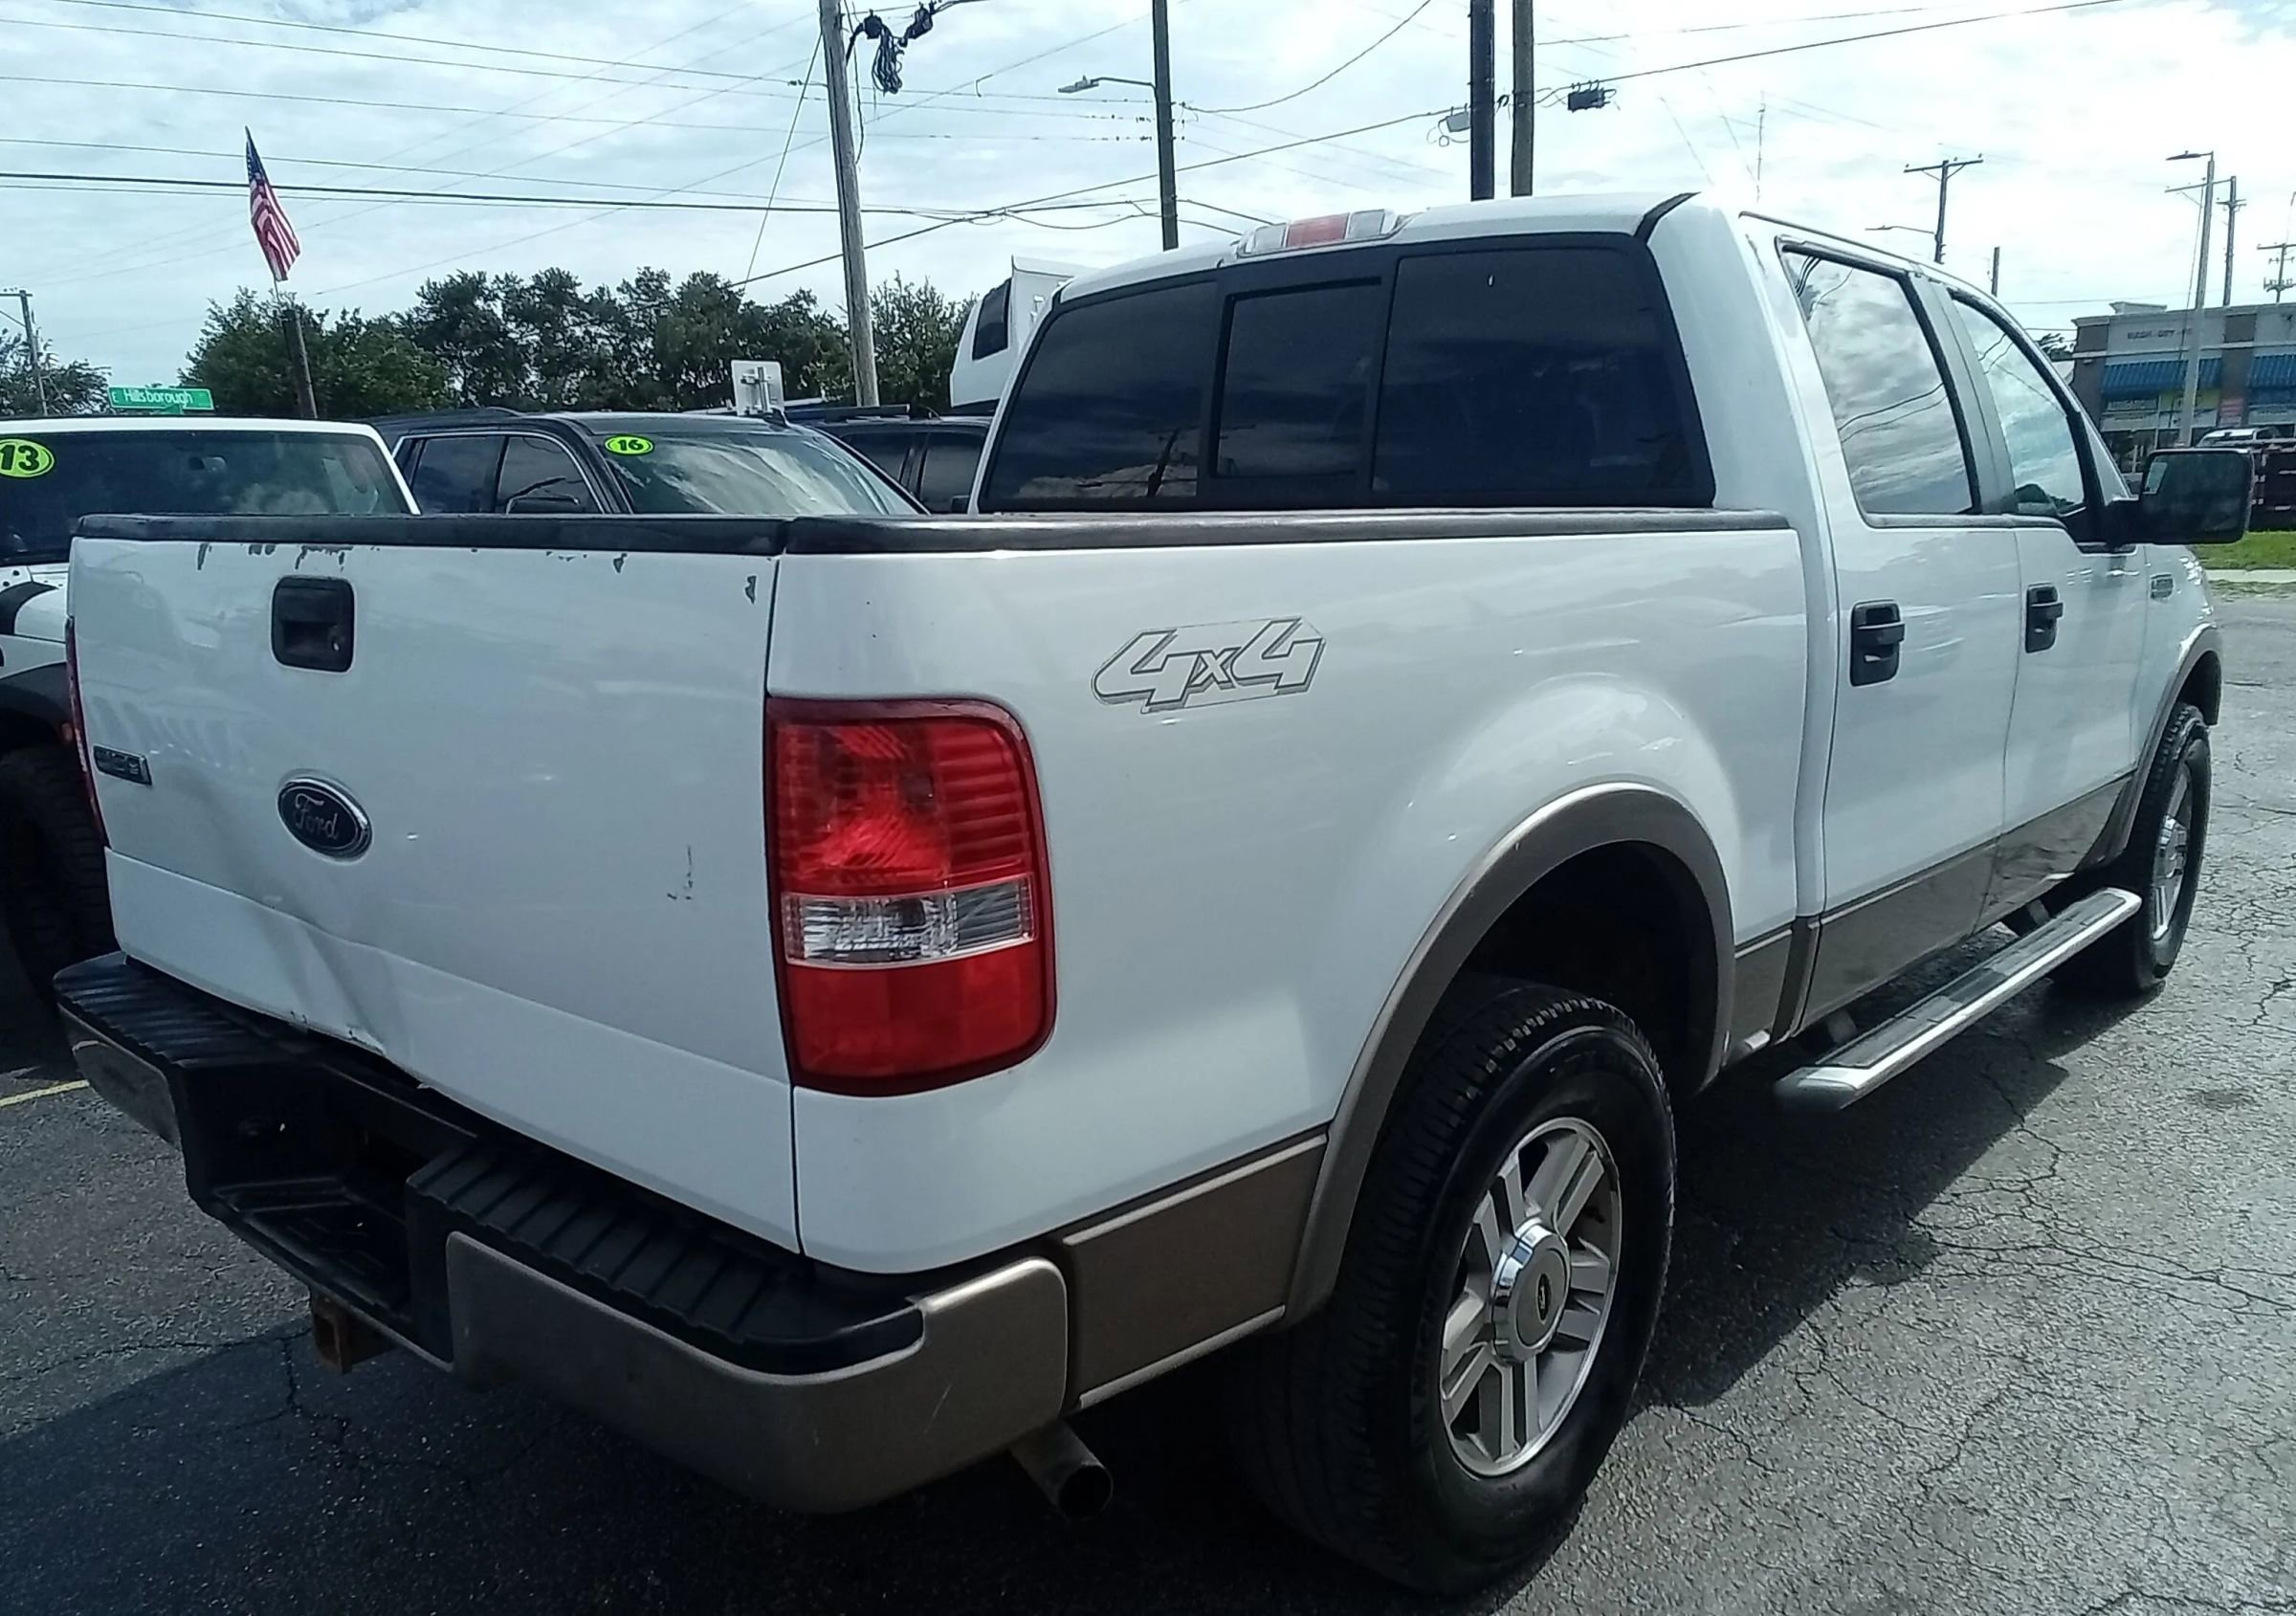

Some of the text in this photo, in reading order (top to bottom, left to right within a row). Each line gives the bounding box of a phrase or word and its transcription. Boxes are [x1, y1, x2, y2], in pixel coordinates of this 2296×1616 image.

[122, 387, 193, 407] Hillsborough
[0, 444, 40, 472] 13
[617, 439, 644, 451] 16
[1091, 617, 1324, 712] 4x4
[294, 792, 339, 840] Ford
